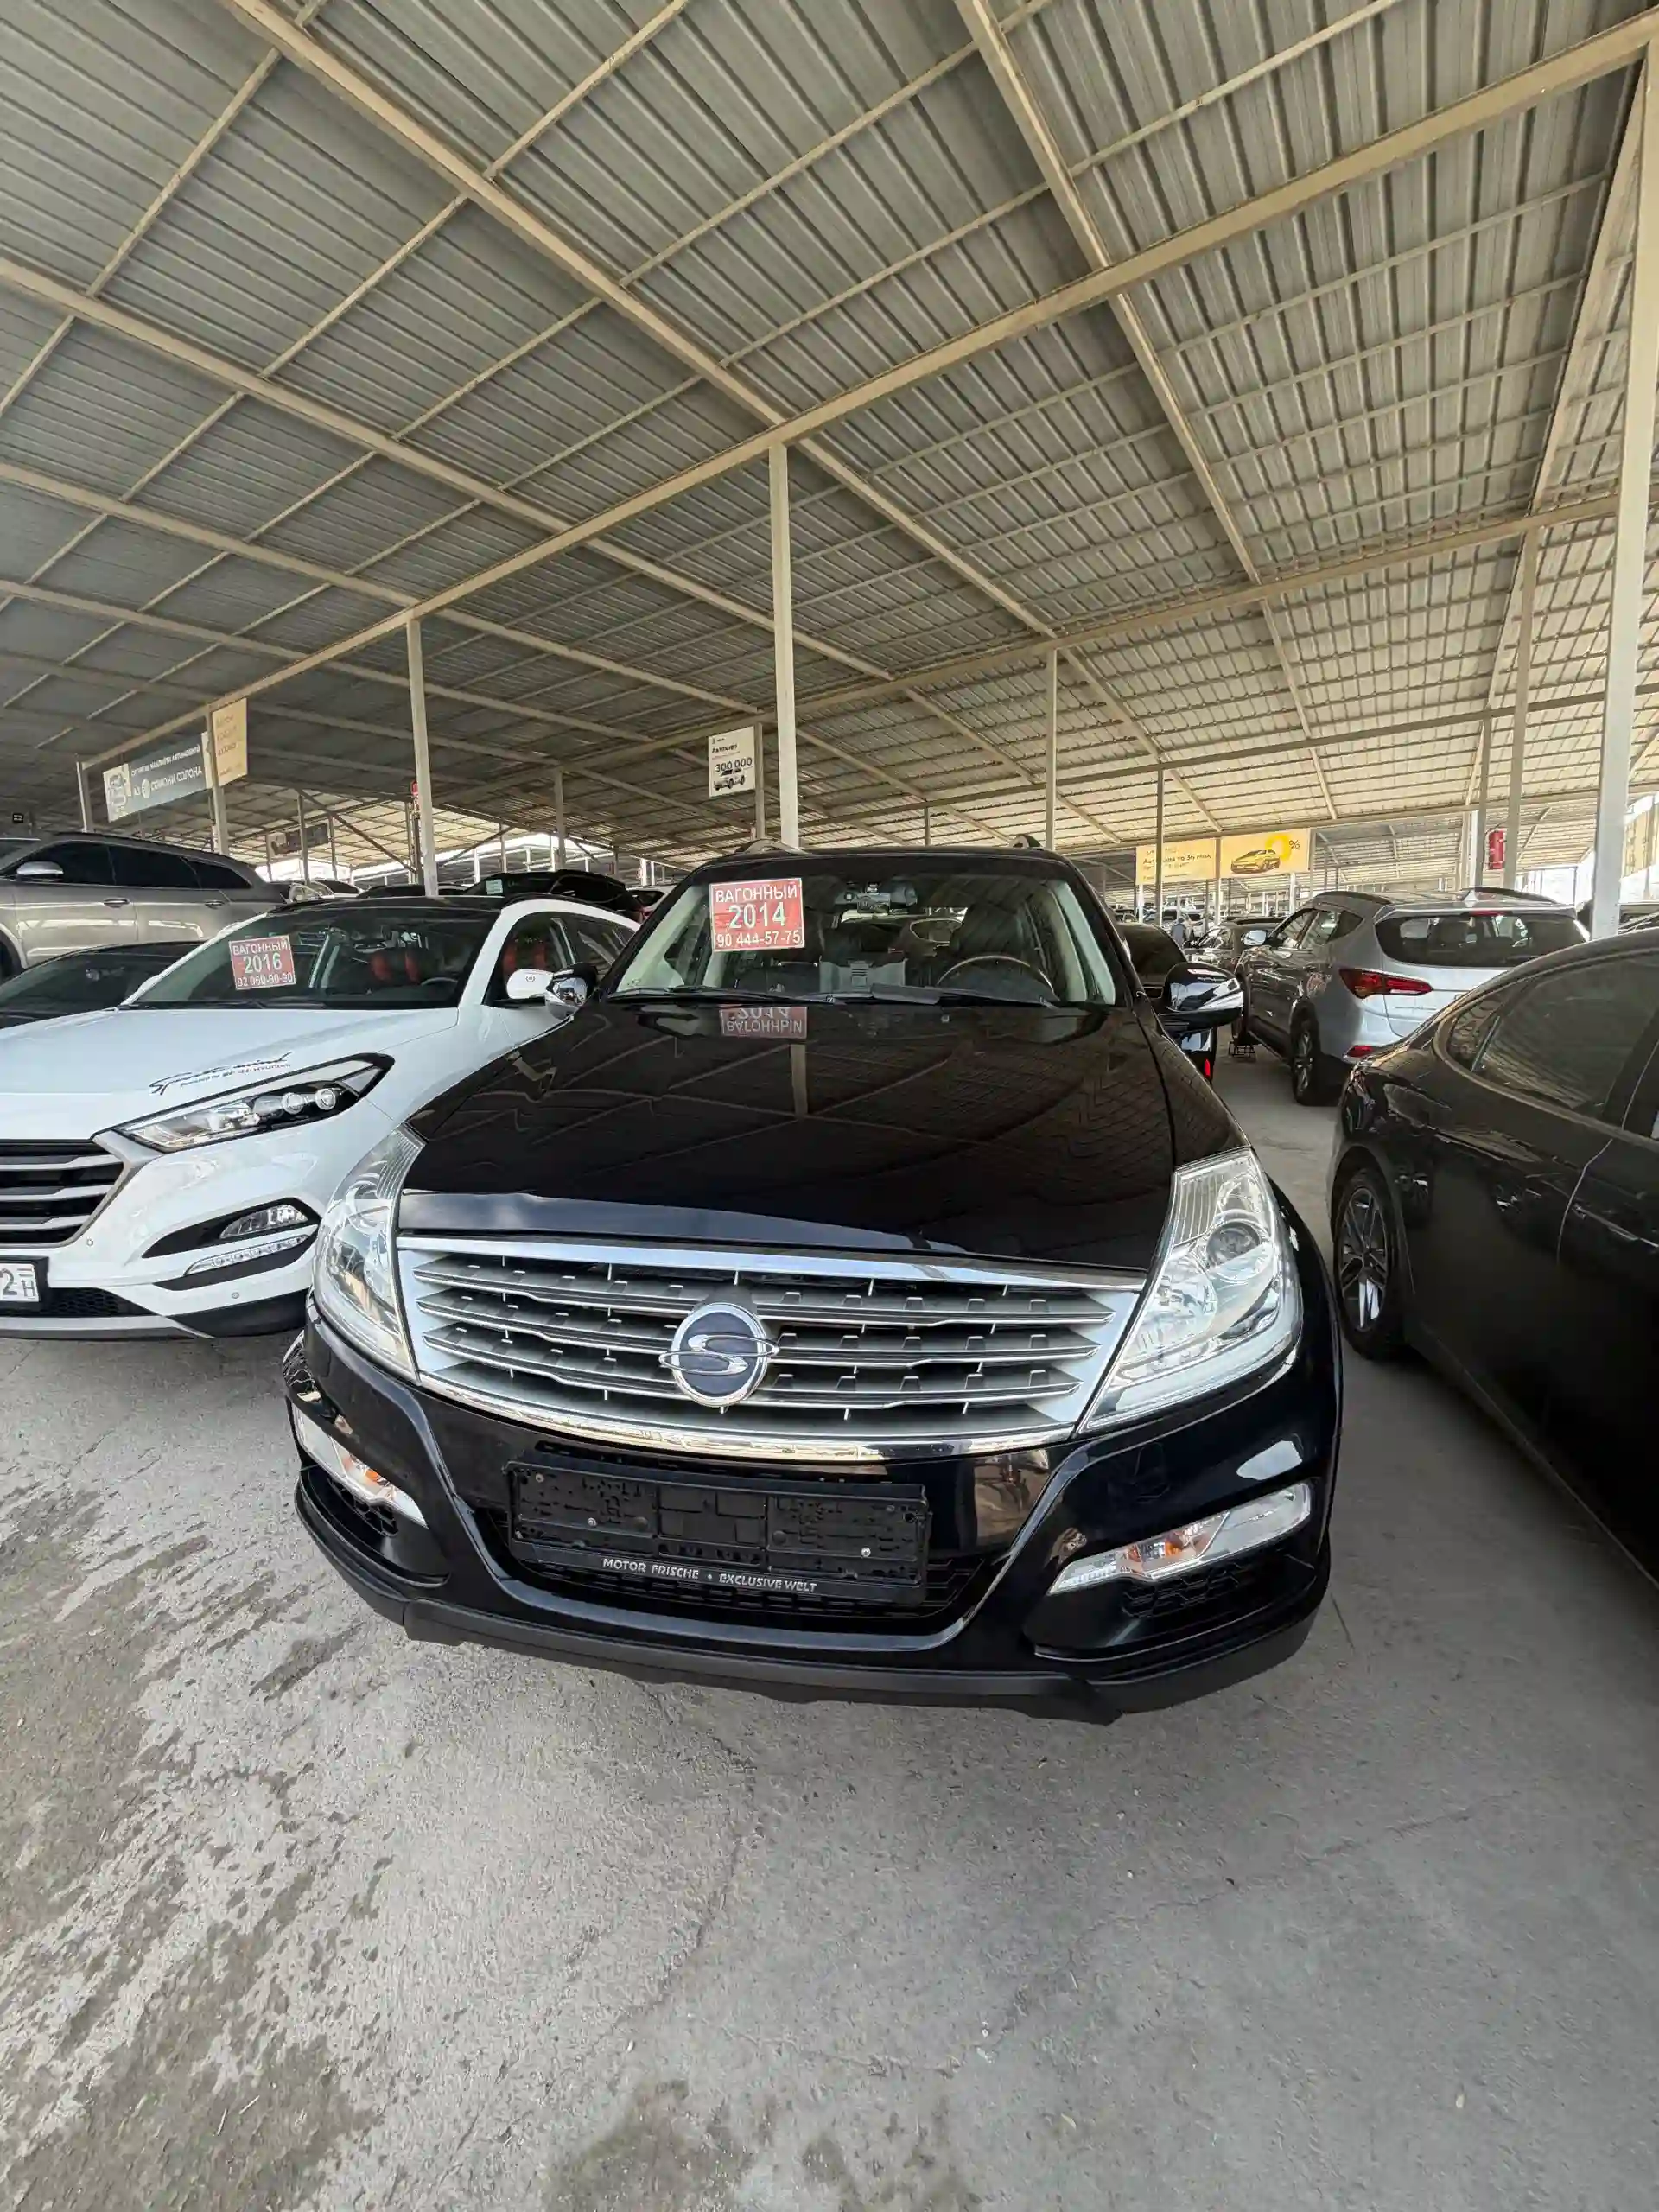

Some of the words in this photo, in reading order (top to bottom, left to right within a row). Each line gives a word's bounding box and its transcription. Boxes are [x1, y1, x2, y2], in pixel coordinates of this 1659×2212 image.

[715, 760, 732, 772] 300
[734, 757, 752, 768] 000
[715, 882, 798, 903] ВАГОННЫЙ
[728, 902, 786, 929] 2014
[232, 938, 288, 956] ВАГОННЫЙ
[716, 933, 733, 948] 90
[736, 930, 801, 946] 444-57-75
[244, 952, 283, 974] 2016
[602, 1558, 646, 1573] MOTOR
[652, 1564, 699, 1580] FRISCHE
[719, 1573, 782, 1589] EXCLUSIVE
[785, 1581, 817, 1593] WELT
